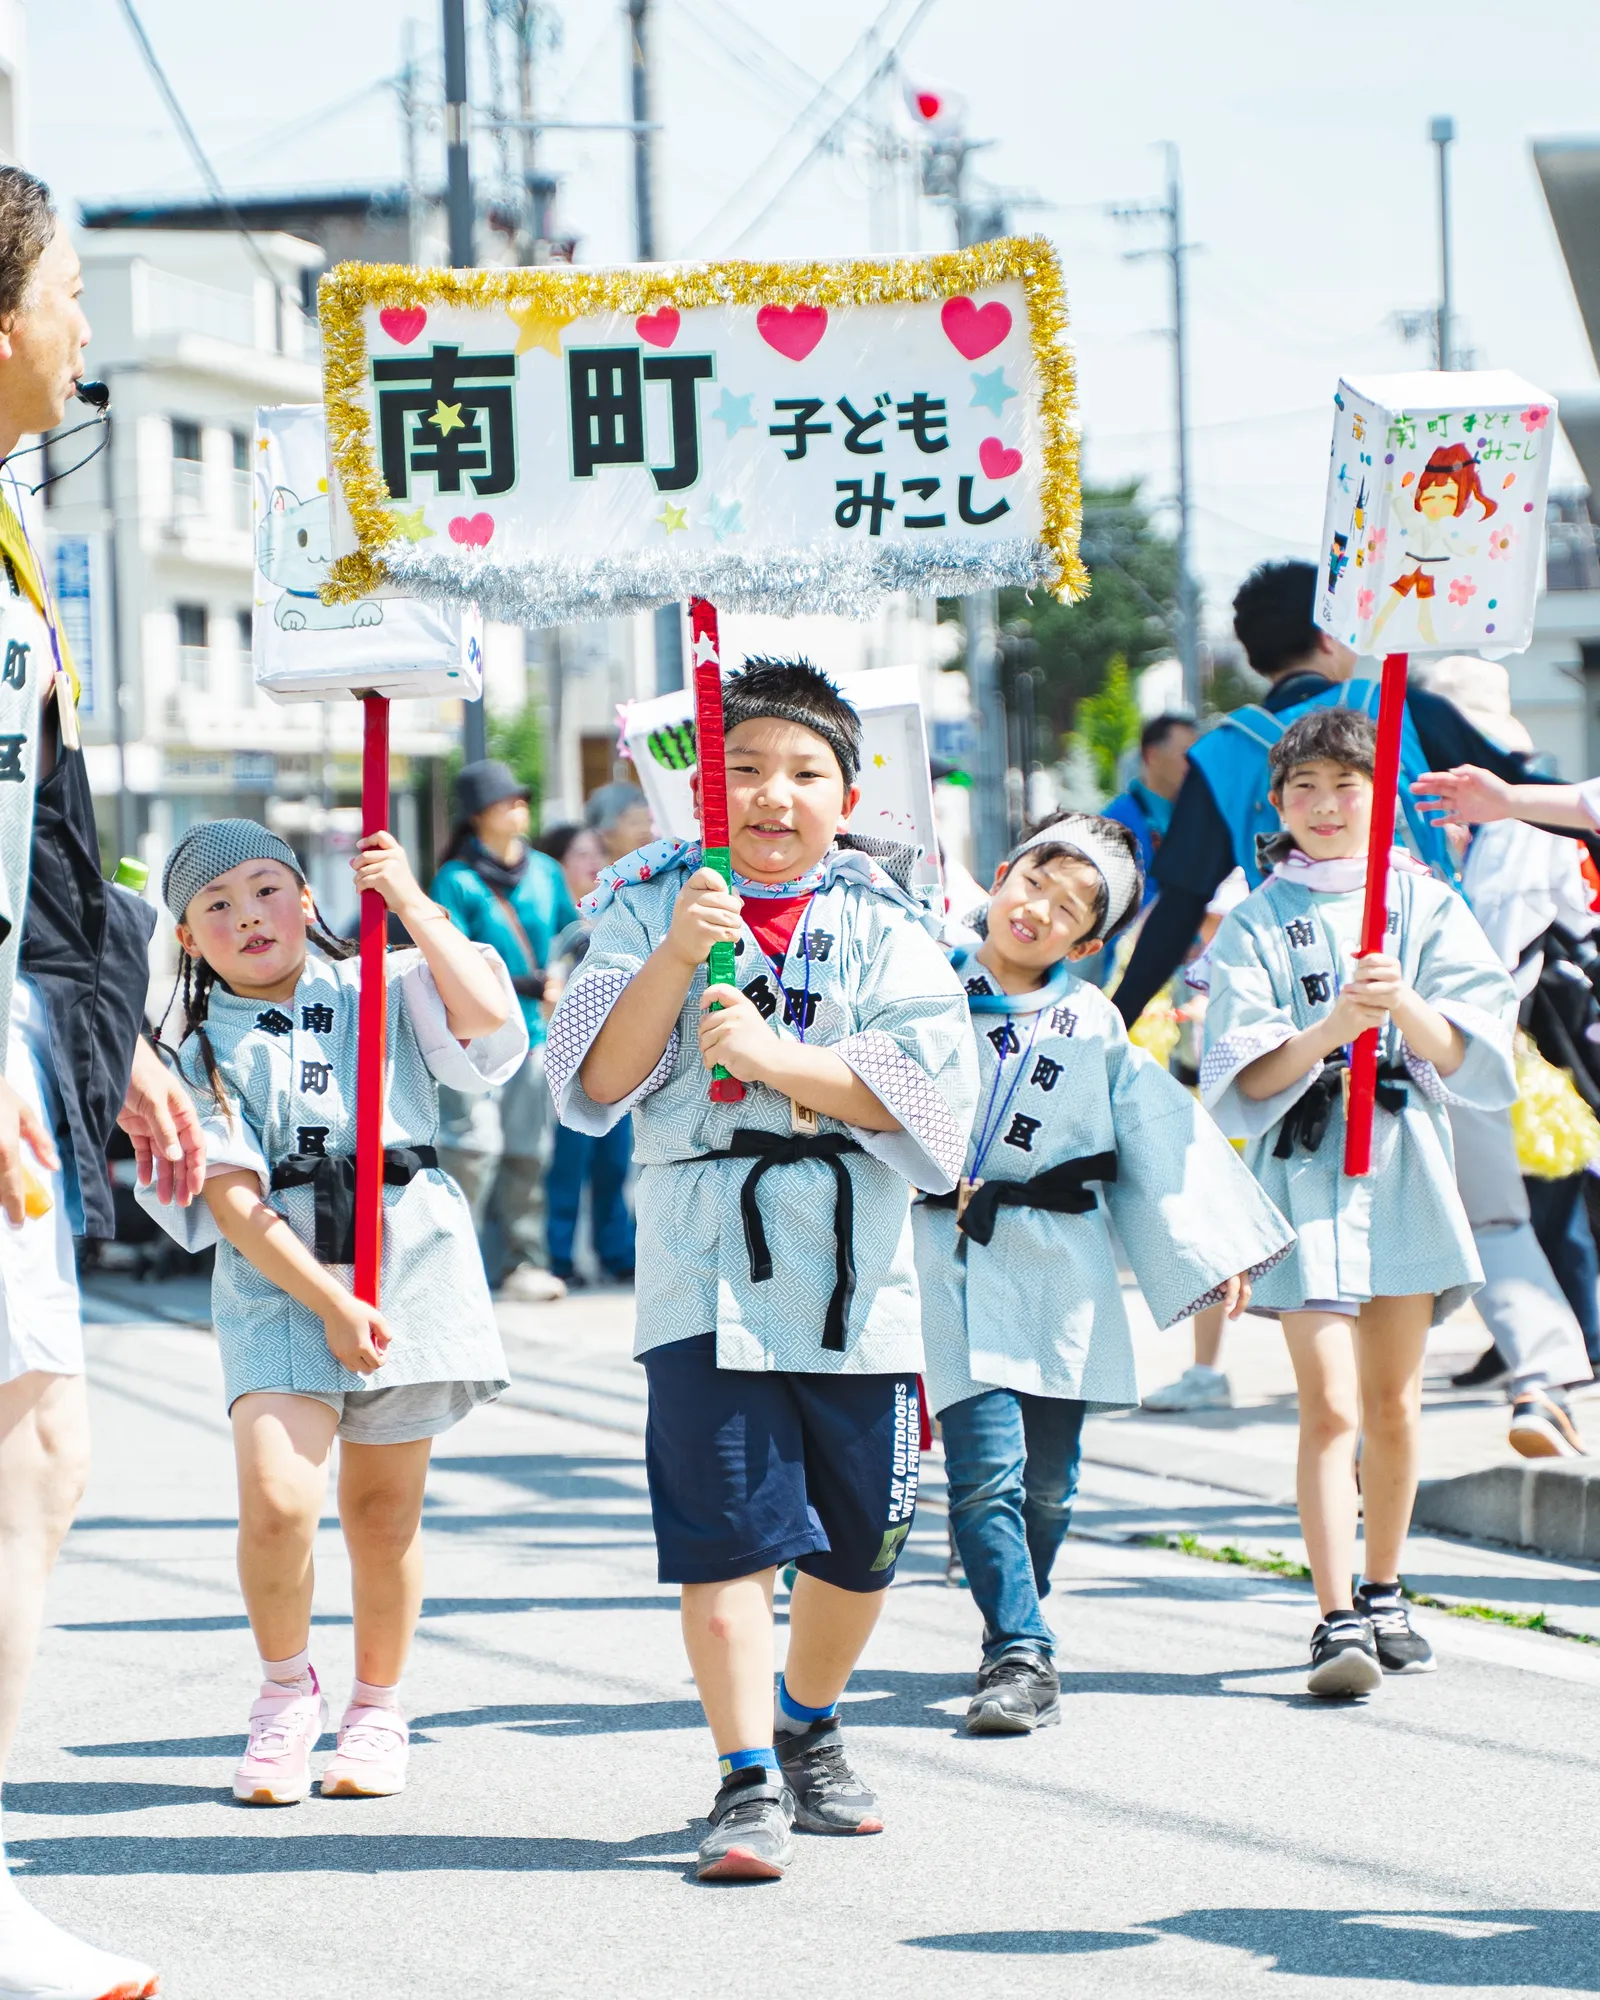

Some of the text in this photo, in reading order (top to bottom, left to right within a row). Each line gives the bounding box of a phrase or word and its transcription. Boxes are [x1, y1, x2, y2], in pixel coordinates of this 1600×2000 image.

[371, 343, 950, 500] 南町 子ども
[1482, 438, 1538, 460] みこし
[835, 471, 1010, 535] みこし
[888, 1382, 908, 1522] PLAY OUTDOORS
[901, 1397, 921, 1519] WITH FRIENDS
